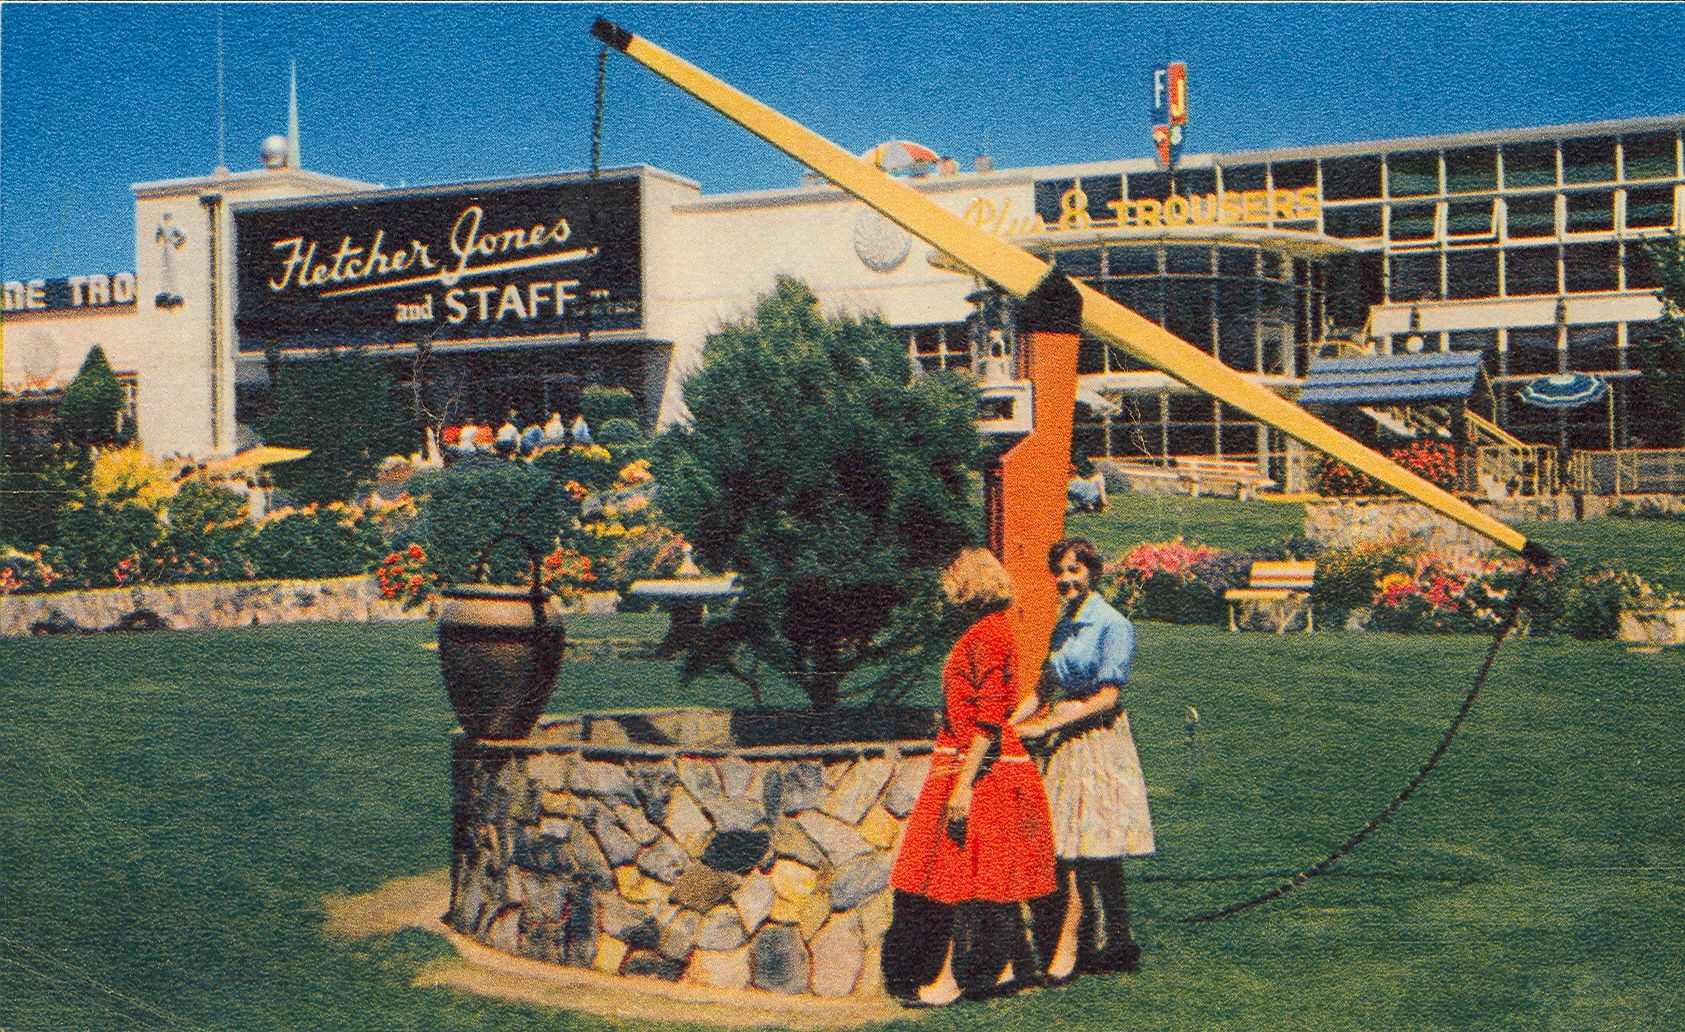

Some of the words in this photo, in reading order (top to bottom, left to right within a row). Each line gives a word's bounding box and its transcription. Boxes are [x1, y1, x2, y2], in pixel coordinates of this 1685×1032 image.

[1106, 187, 1319, 228] TROUSERS
[268, 228, 440, 293] Fletcher
[440, 204, 573, 286] Jones
[395, 293, 434, 324] and
[444, 279, 581, 326] STAFF
